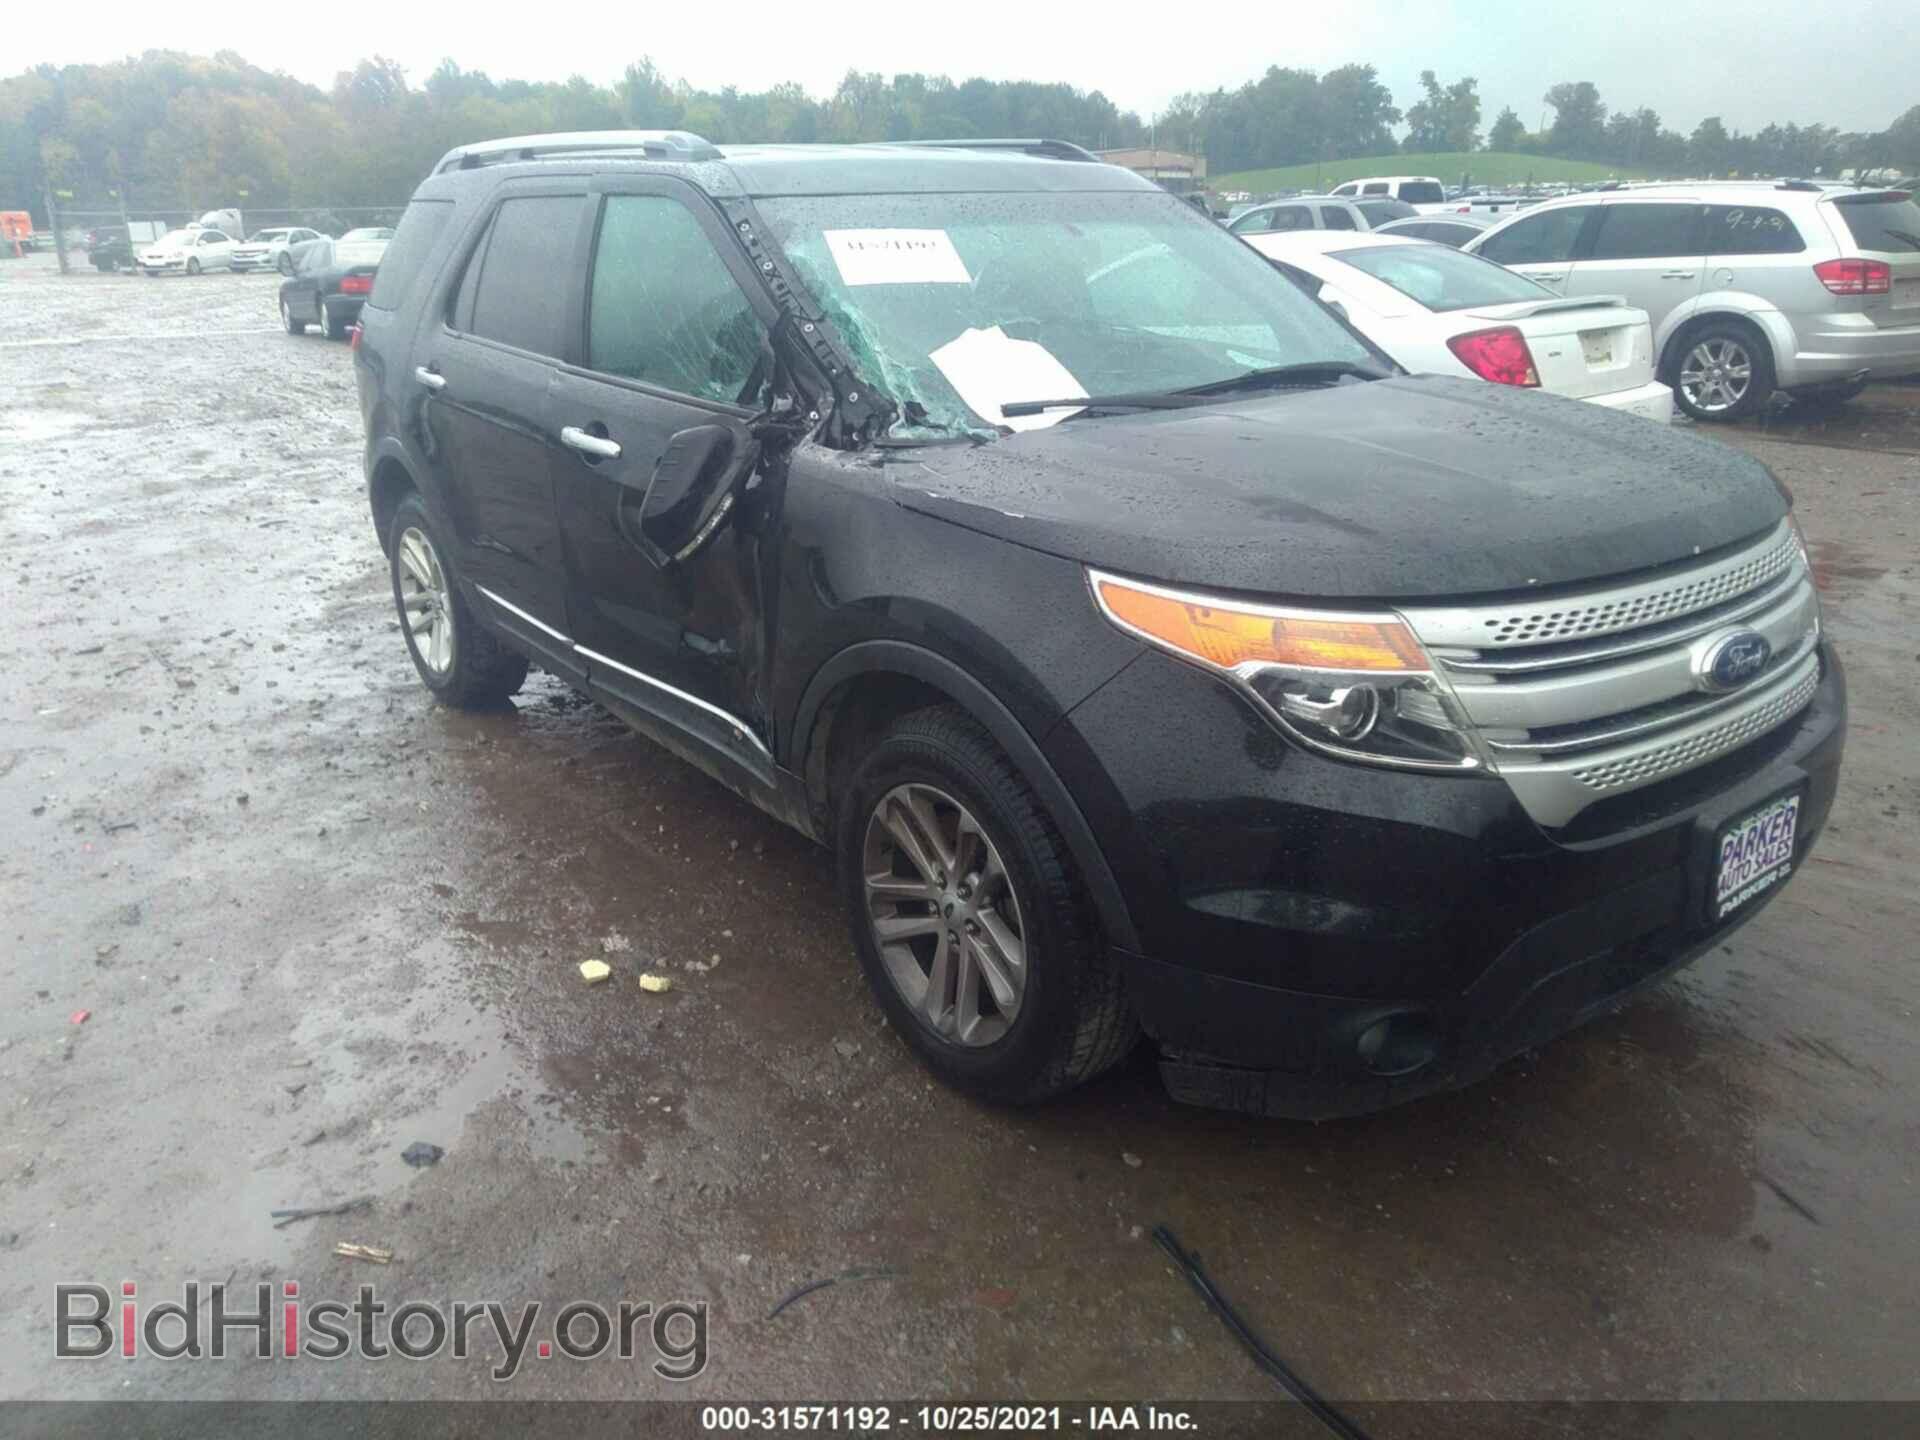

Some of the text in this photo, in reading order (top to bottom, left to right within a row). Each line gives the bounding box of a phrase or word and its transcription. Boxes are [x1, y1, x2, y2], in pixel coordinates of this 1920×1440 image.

[1728, 641, 1763, 680] Ford
[1718, 859, 1752, 893] AUTO
[1753, 836, 1791, 874] SALES
[1722, 805, 1795, 868] PARKER
